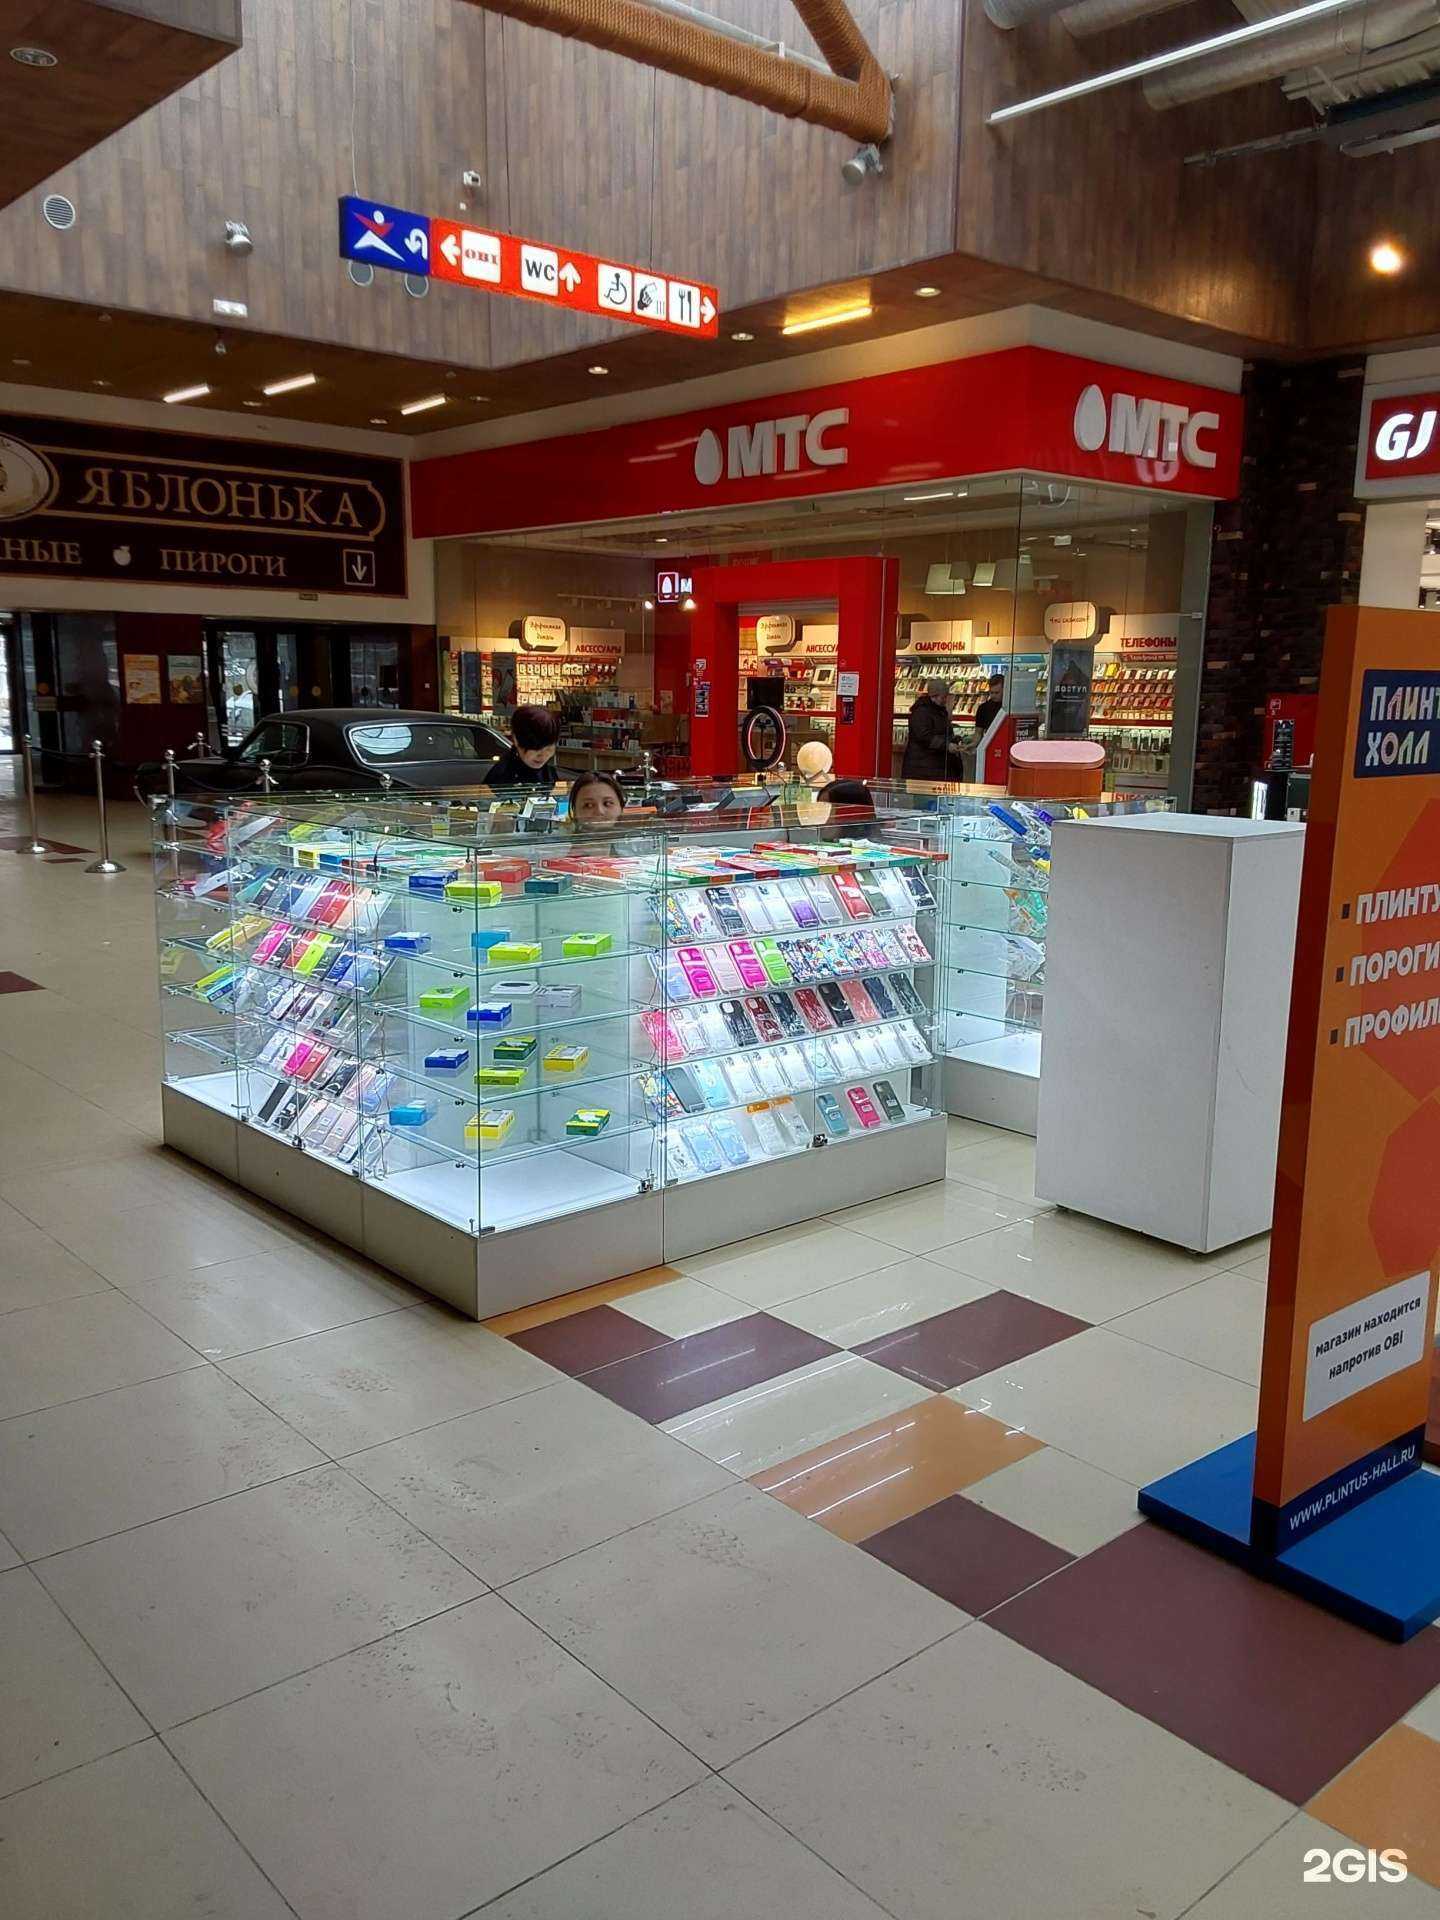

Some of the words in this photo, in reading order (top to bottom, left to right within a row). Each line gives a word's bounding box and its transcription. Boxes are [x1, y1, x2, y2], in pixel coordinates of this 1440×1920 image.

[465, 249, 498, 265] OBI
[525, 258, 555, 281] WC
[728, 407, 850, 480] МТС
[1108, 392, 1220, 469] МТС
[1376, 410, 1438, 461] GJ
[77, 467, 363, 529] ЯБЛОНЬКА
[0, 538, 83, 566] НЫЕ
[160, 548, 288, 577] ПИРОГИ
[915, 641, 965, 651] СМАРТФОНЫ
[1120, 637, 1176, 648] ТЕЛЕФОНЫ
[1365, 730, 1430, 767] ХОЛЛ
[1350, 940, 1440, 986] ПОРОГИ
[1344, 997, 1440, 1048] ПРОФИЛ
[1315, 1325, 1361, 1357] магазин
[1363, 1297, 1421, 1332] находится
[1329, 1344, 1381, 1379] напротив
[1289, 1445, 1416, 1531] WWW.PLINTUS-HALL.RU
